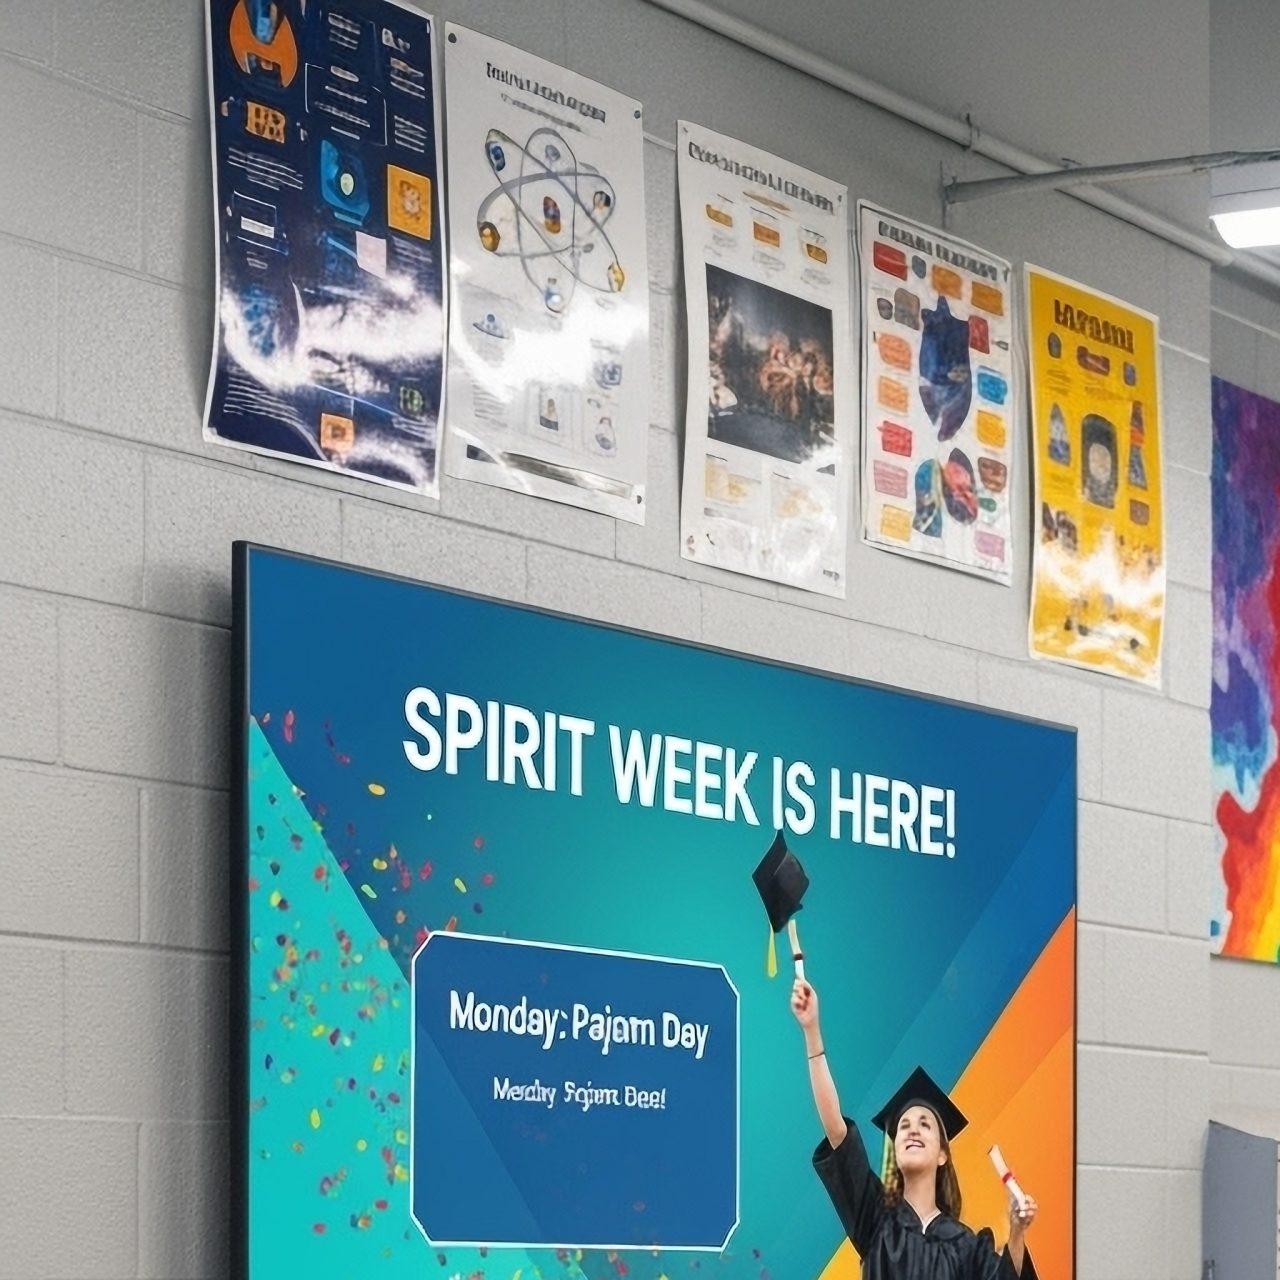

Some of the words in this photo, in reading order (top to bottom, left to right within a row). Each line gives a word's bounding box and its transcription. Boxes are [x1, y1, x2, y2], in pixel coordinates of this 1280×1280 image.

[402, 686, 595, 796] SPIRIT
[608, 724, 760, 826] WEEK
[772, 756, 816, 835] IS
[830, 767, 956, 859] HERE!
[450, 990, 568, 1050] Monday:
[662, 1011, 709, 1060] Day
